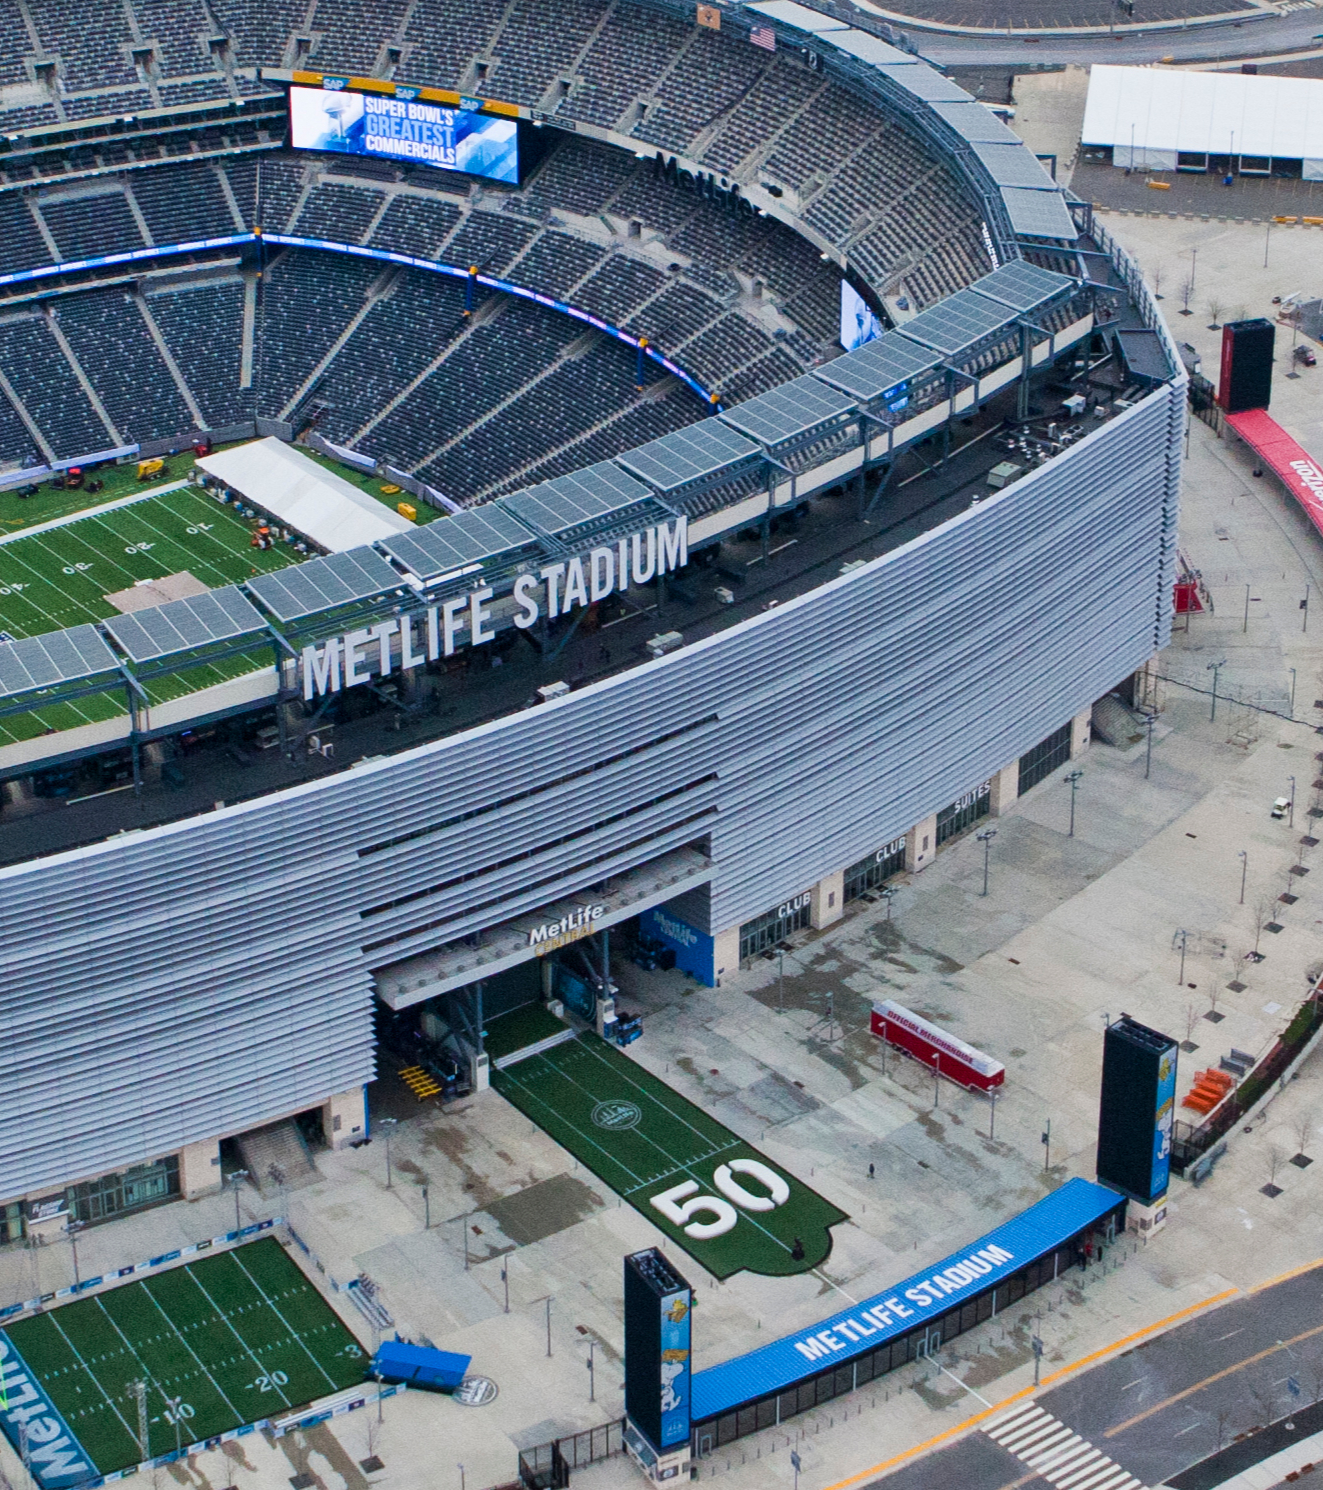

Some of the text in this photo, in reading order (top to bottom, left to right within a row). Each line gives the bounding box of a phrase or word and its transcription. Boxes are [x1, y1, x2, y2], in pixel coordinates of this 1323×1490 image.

[323, 78, 344, 90] SAP
[395, 88, 415, 100] SAP
[365, 96, 454, 126] SUPER BOWL'S
[460, 99, 478, 111] SAP
[366, 114, 455, 148] GREATEST
[365, 135, 456, 164] COMMERCIALS
[1289, 460, 1323, 504] erizon
[186, 521, 211, 535] 10
[125, 541, 150, 555] 20
[62, 562, 88, 575] 30
[302, 515, 688, 701] METLIFE STADIUM
[954, 780, 991, 814] SUITES
[876, 836, 906, 864] CLUB
[778, 891, 811, 919] CLUB
[529, 904, 605, 946] MetLife
[887, 1010, 974, 1064] OFFICIAL MERCHANDISE
[649, 1158, 790, 1240] 50
[794, 1244, 1015, 1361] METLIFE STADIUM
[257, 1370, 290, 1393] 20
[163, 1403, 196, 1425] 10
